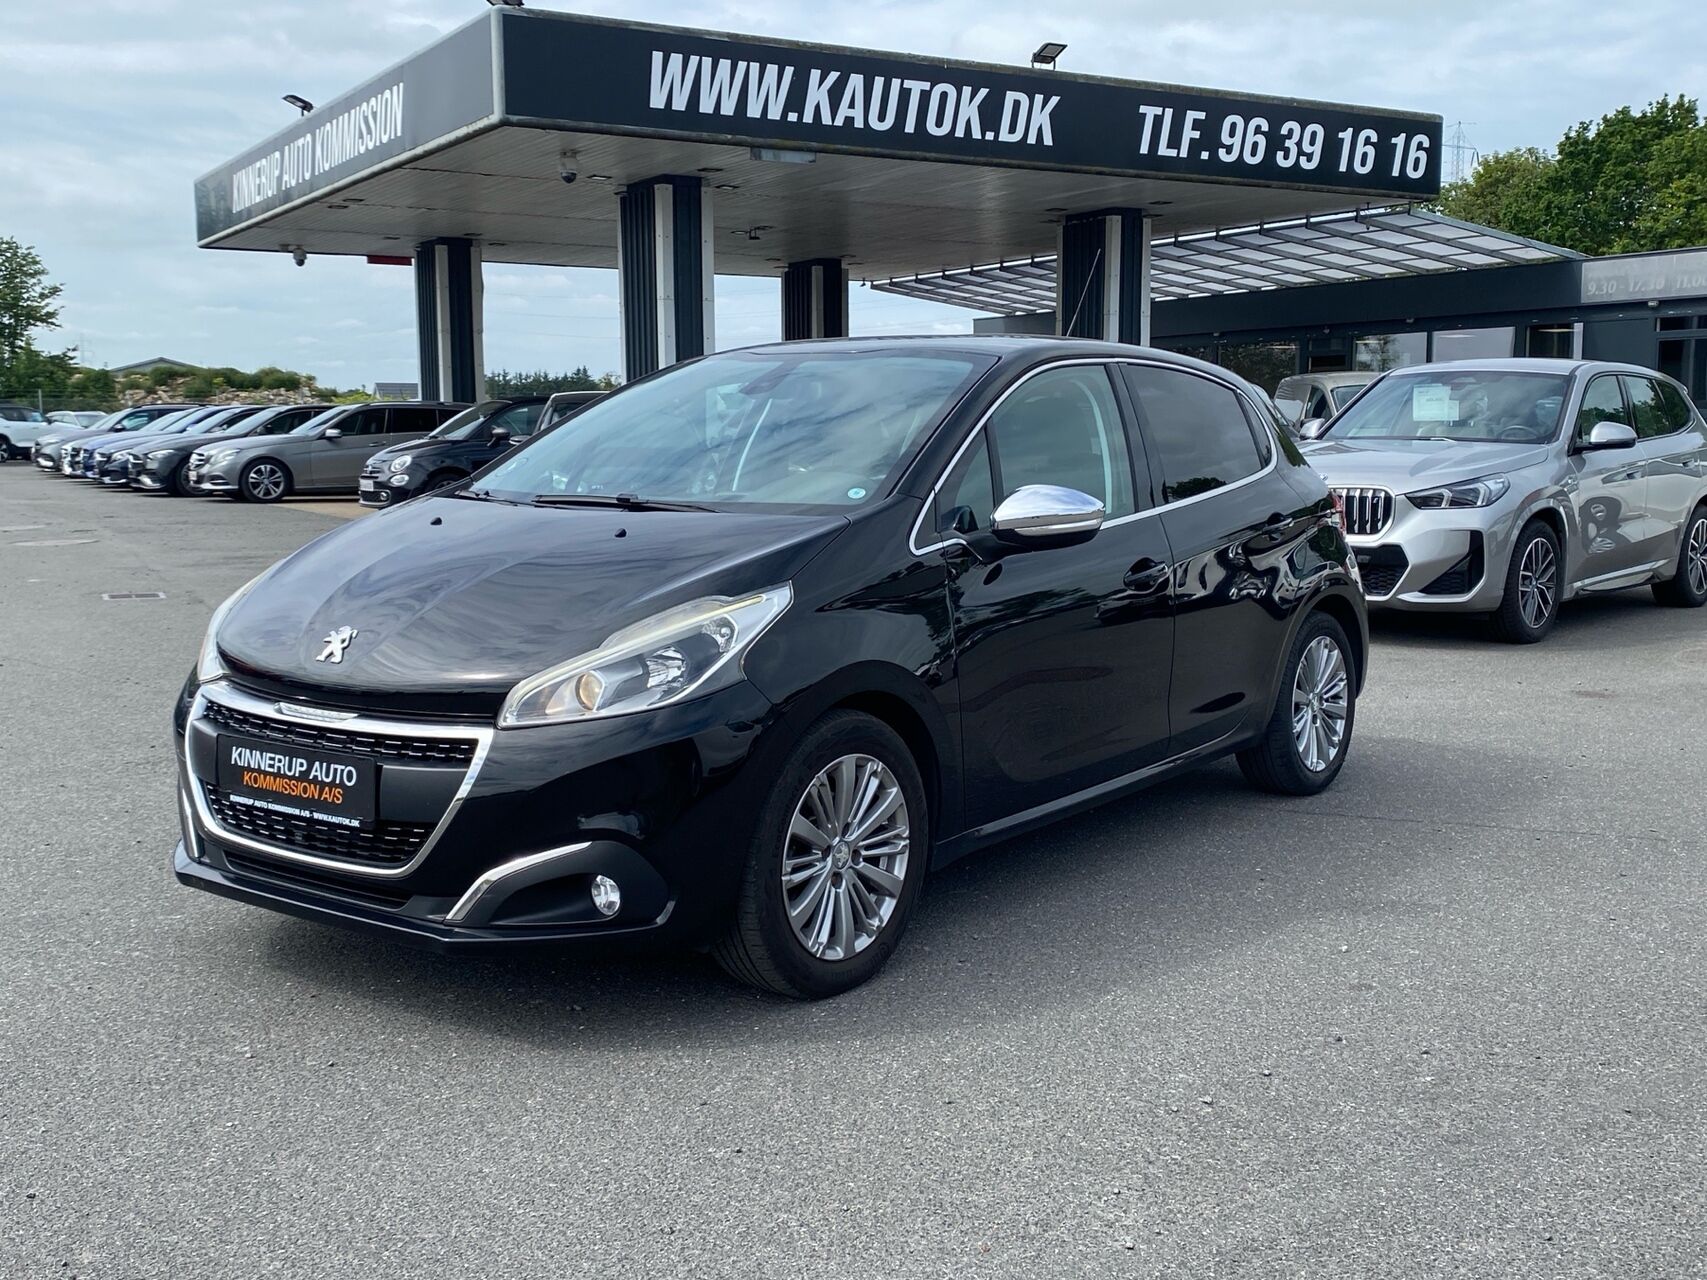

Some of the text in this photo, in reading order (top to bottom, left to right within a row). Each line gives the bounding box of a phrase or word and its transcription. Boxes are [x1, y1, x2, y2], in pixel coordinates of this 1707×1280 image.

[649, 50, 1061, 146] WWW.KAUTOK.DK
[232, 82, 405, 213] KINNERUP AUTO KOMMISSION
[1138, 104, 1430, 180] TLF. 96 39 16 16
[230, 746, 357, 787] KINNERUP AUTO
[243, 771, 343, 805] KOMMISSION A/S
